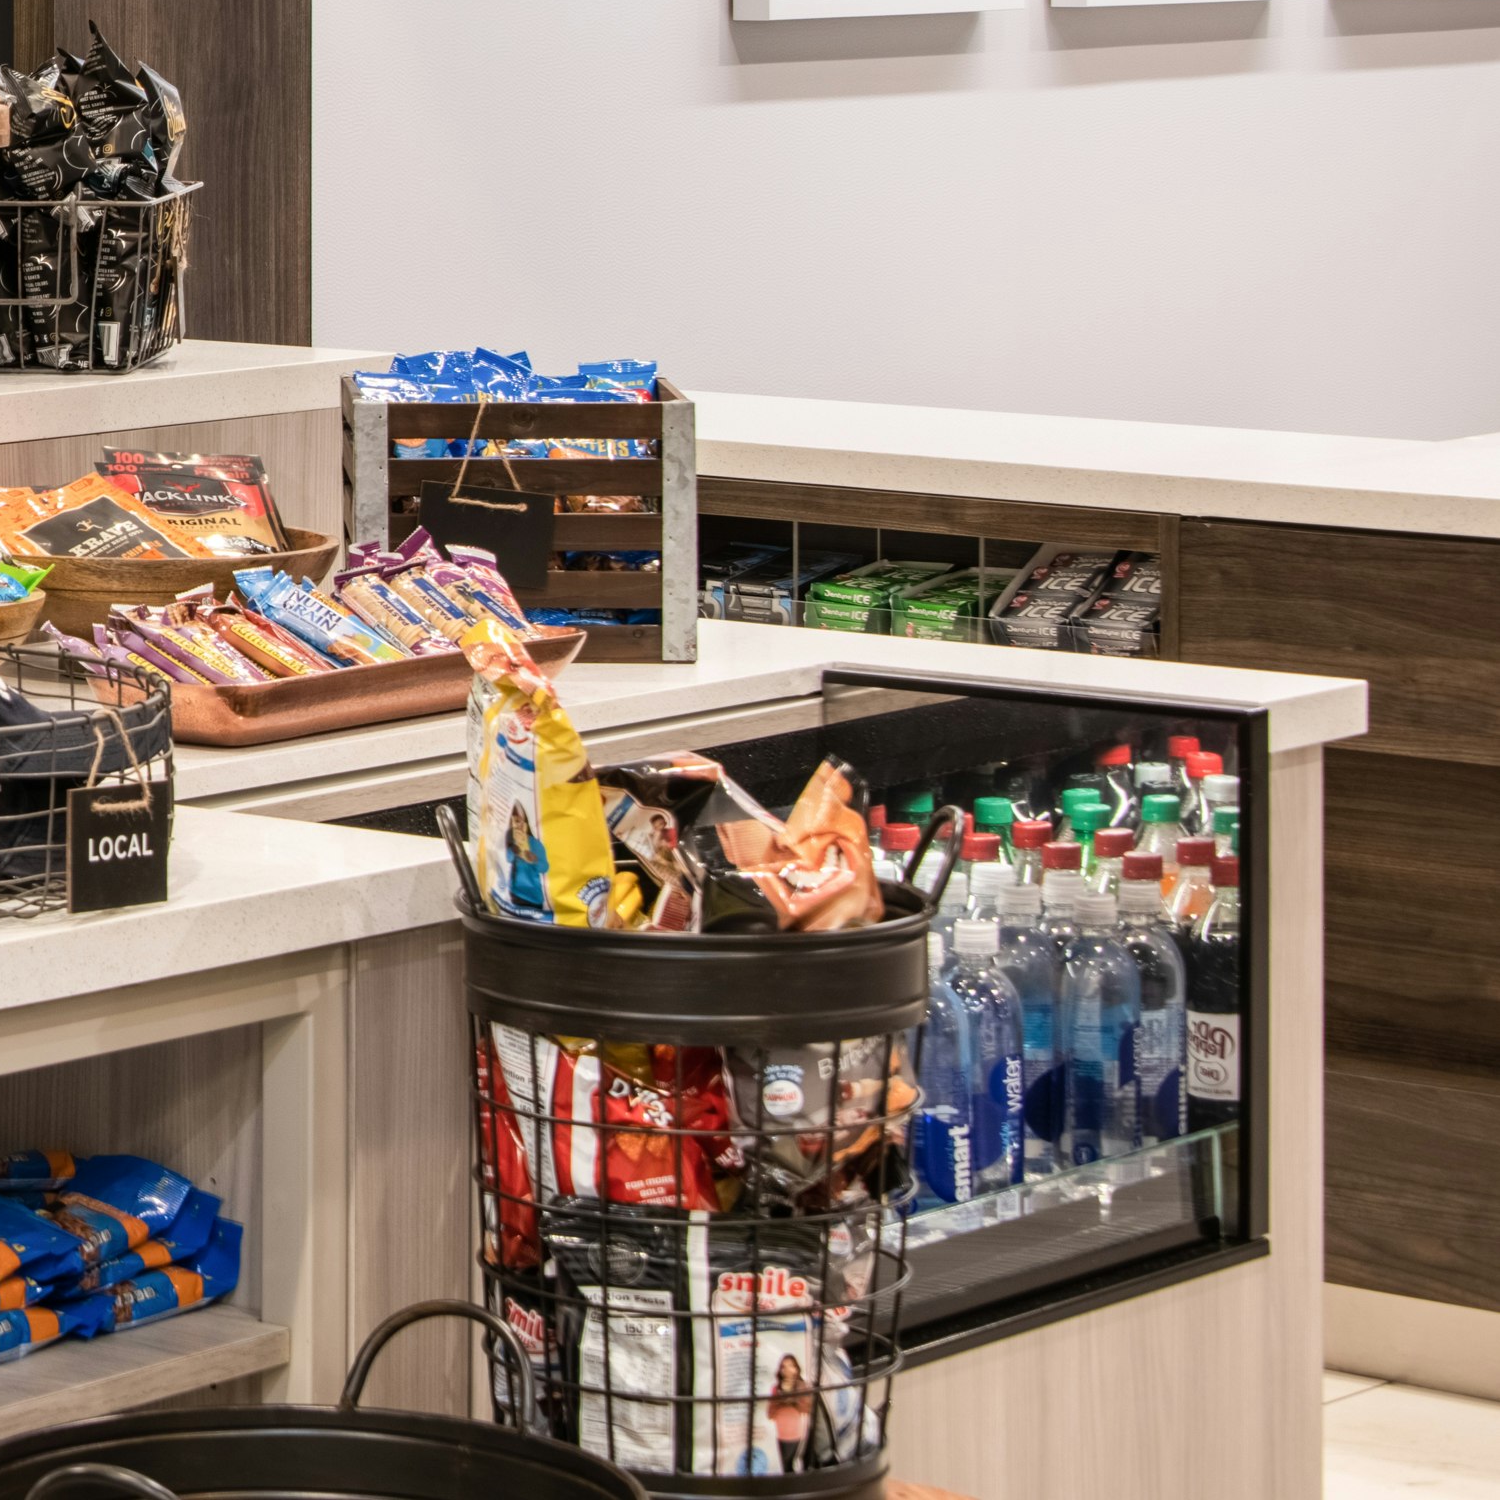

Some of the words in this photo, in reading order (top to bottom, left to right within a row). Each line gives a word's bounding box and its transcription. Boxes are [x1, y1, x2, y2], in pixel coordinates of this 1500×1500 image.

[113, 452, 144, 464] 100
[107, 464, 137, 472] 100
[166, 517, 241, 526] RIGINAL
[69, 520, 139, 557] KRAVE
[1038, 577, 1087, 590] ICE
[853, 594, 871, 605] ICE
[293, 589, 342, 624] NUTRI
[1017, 606, 1068, 618] ICE
[851, 612, 869, 621] ICE
[937, 610, 957, 621] ICE
[1100, 609, 1149, 622] ICE
[1039, 627, 1058, 636] ICE
[1120, 629, 1142, 640] ICE
[88, 831, 154, 864] LOCAL
[1006, 1057, 1021, 1113] water
[950, 1124, 971, 1201] smart
[719, 1266, 806, 1298] smile
